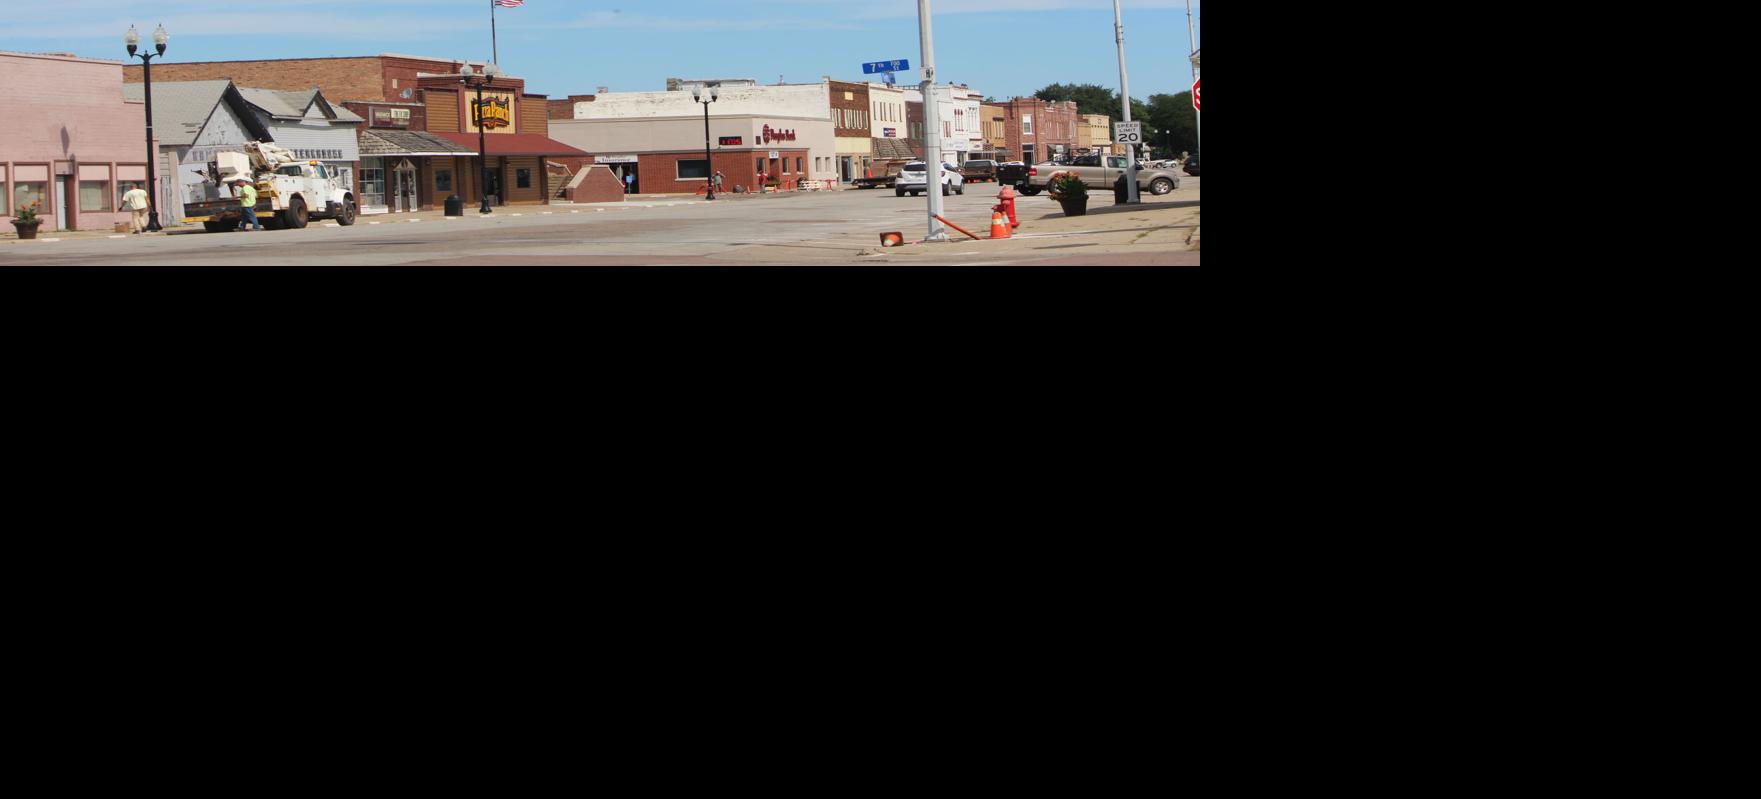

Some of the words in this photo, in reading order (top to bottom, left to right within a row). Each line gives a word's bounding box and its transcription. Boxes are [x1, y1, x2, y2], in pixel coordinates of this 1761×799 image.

[869, 63, 876, 72] 7
[491, 101, 509, 122] Ranch
[1118, 133, 1138, 142] 20
